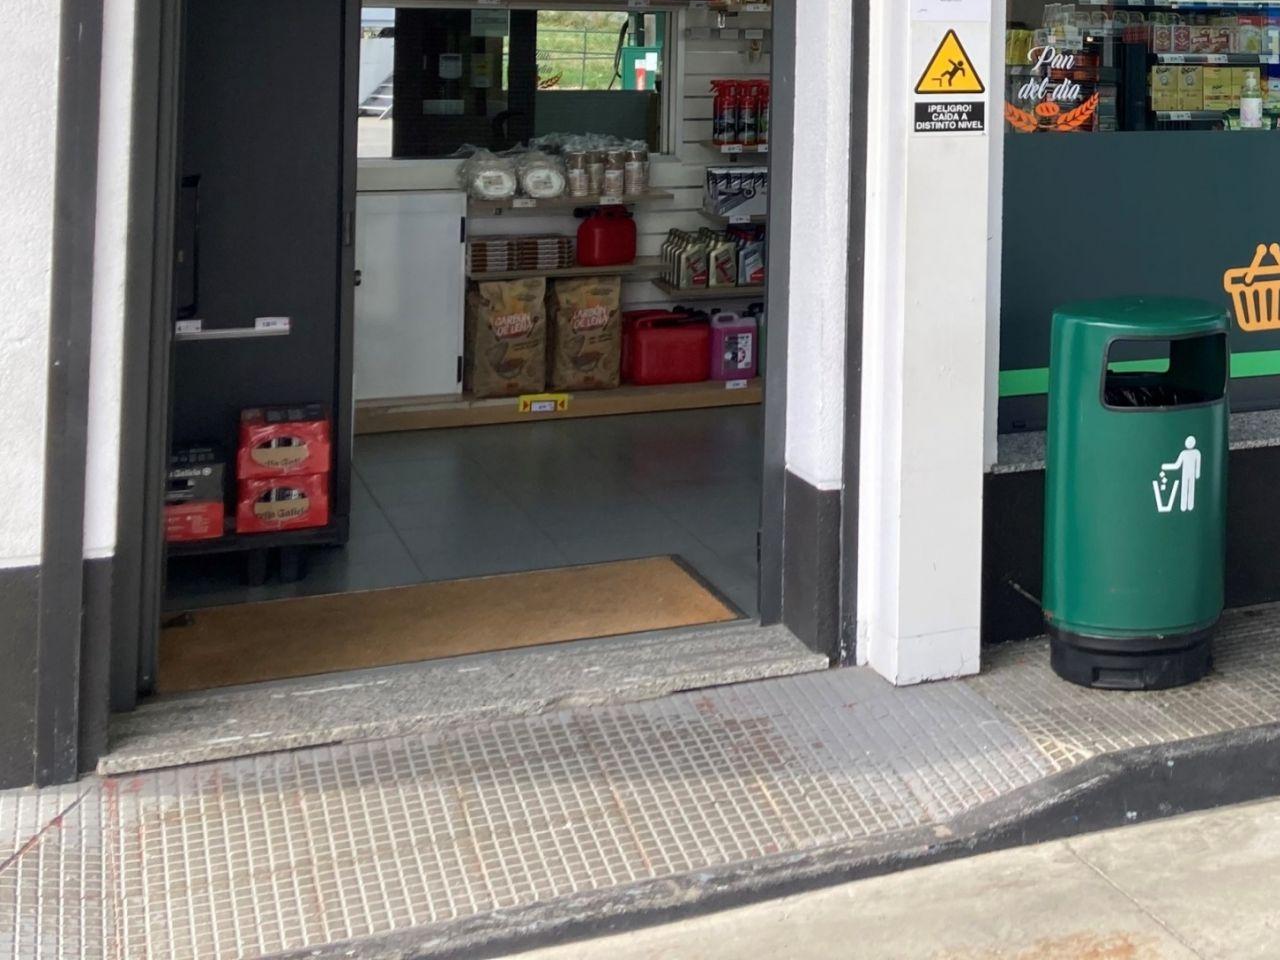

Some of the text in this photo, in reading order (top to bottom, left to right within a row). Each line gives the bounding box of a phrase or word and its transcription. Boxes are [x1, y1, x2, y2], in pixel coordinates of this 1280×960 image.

[1027, 45, 1075, 71] Pan
[1018, 77, 1049, 100] del
[927, 104, 972, 113] ¡PELIGRO!
[916, 120, 983, 130] DISTINTO NIVEL
